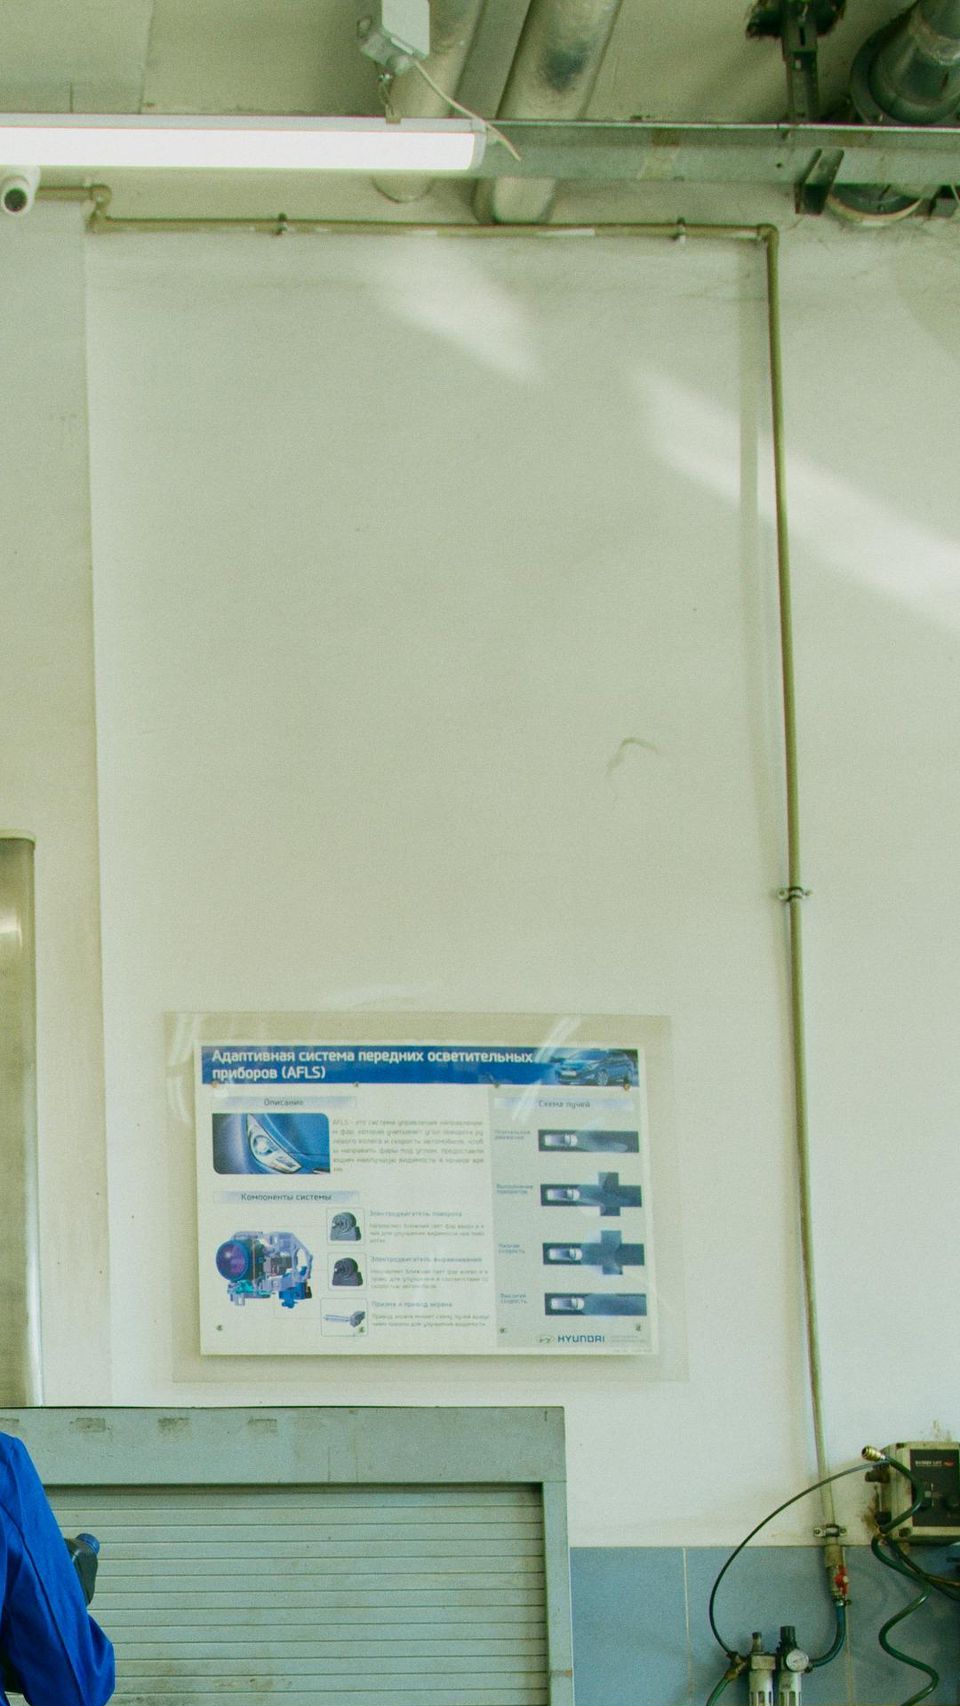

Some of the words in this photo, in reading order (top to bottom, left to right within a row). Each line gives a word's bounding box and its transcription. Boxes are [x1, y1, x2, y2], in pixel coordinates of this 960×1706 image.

[212, 1050, 296, 1064] Адаптивная
[299, 1051, 355, 1062] система
[358, 1051, 424, 1064] передних
[427, 1051, 533, 1063] осветительных
[212, 1066, 278, 1081] приборов
[281, 1066, 326, 1080] (AFLS)
[264, 1098, 304, 1106] Описание
[240, 1193, 294, 1201] Компоненты
[295, 1193, 332, 1201] системы
[557, 1334, 605, 1344] HYUNDAI
